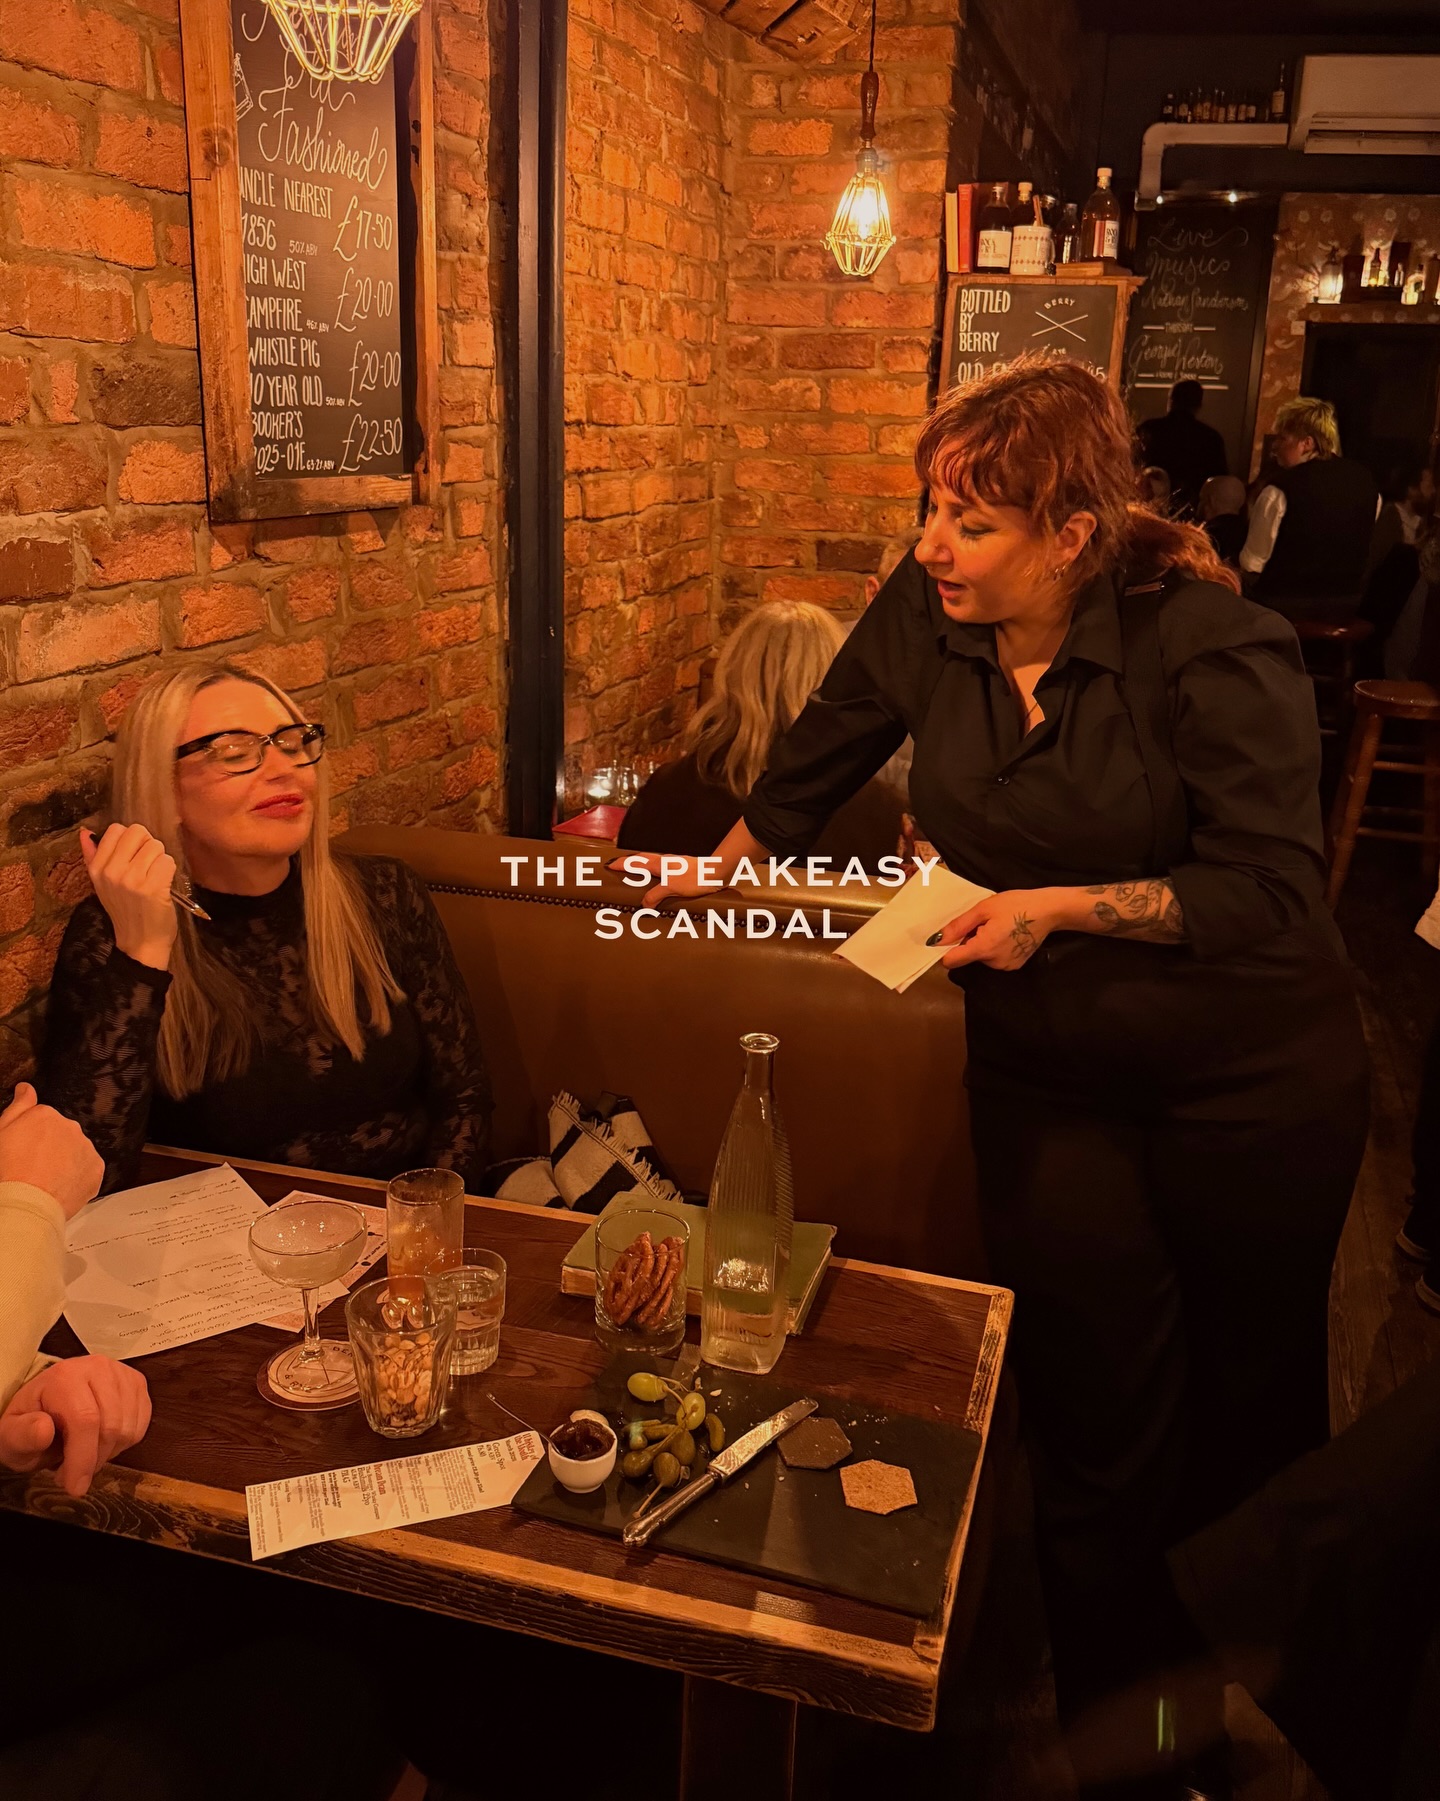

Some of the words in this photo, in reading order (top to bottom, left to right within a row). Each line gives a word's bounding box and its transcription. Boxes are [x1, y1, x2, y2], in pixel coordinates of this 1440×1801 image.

[258, 92, 388, 190] Fashioned
[284, 177, 334, 220] NEAREST
[241, 212, 277, 251] 1856
[1147, 217, 1249, 252] Live
[271, 257, 307, 291] WEST
[960, 288, 1011, 314] BOTTLED
[1043, 297, 1076, 310] BERRY
[959, 312, 975, 333] BY
[300, 337, 320, 368] PIG
[958, 331, 1000, 352] BERRY
[250, 372, 264, 405] 10
[266, 374, 299, 407] YEAR
[302, 375, 323, 407] OLD
[957, 362, 984, 385] OLD
